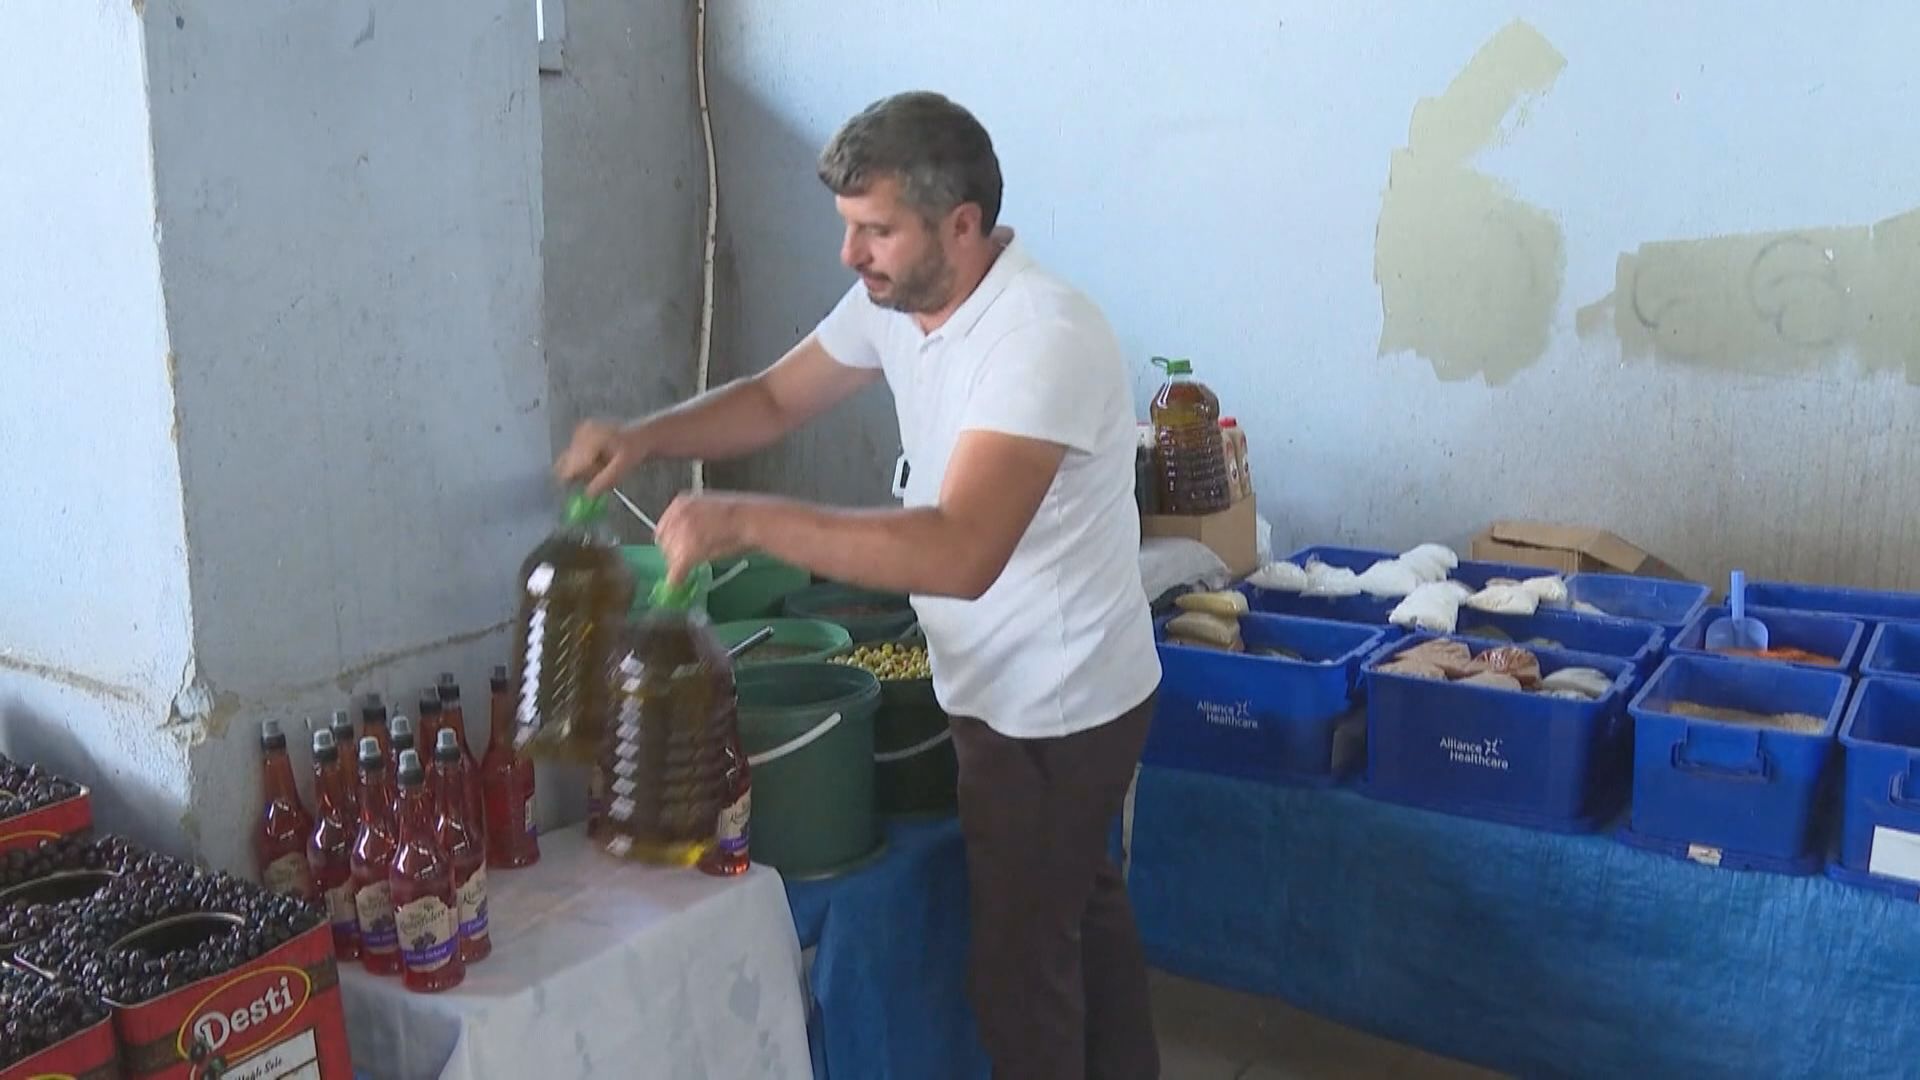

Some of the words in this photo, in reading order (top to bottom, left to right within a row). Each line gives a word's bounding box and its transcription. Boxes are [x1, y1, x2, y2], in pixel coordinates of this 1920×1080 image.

[1197, 700, 1234, 716] Alliance
[1206, 711, 1258, 728] Healthcare
[1440, 737, 1482, 754] Alliance
[1450, 750, 1509, 769] Healthcare
[194, 976, 294, 1052] Desti
